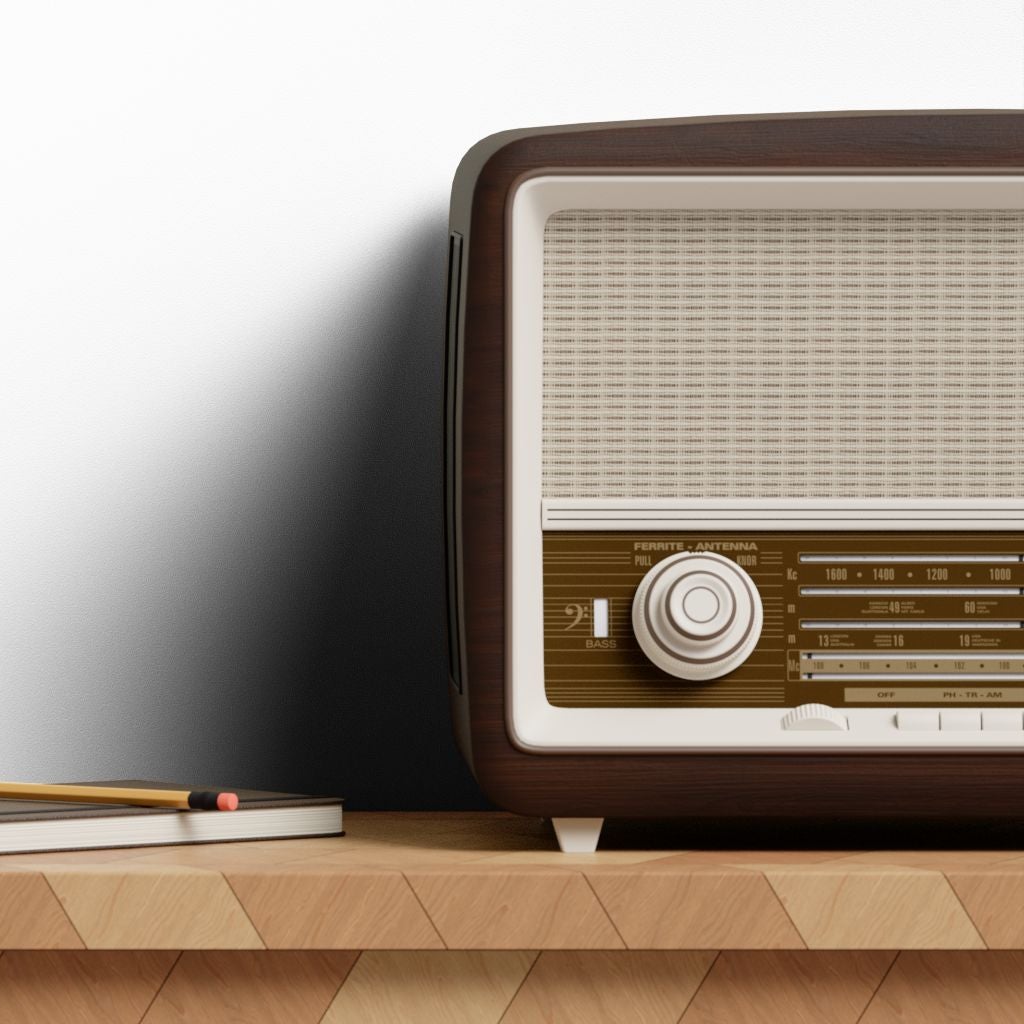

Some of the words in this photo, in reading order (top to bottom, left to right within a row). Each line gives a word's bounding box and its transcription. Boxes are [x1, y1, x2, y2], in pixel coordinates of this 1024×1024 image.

[634, 542, 684, 551] FERRITE
[696, 542, 758, 551] ANTENNA
[635, 556, 652, 566] PULL
[826, 568, 847, 580] 1600
[873, 568, 895, 580] 1400
[927, 568, 948, 580] 1200
[990, 568, 1011, 580] 1000
[965, 601, 975, 613] 60
[586, 640, 616, 648] BASS
[819, 635, 829, 647] 13
[894, 635, 904, 647] 16
[960, 635, 970, 647] 19
